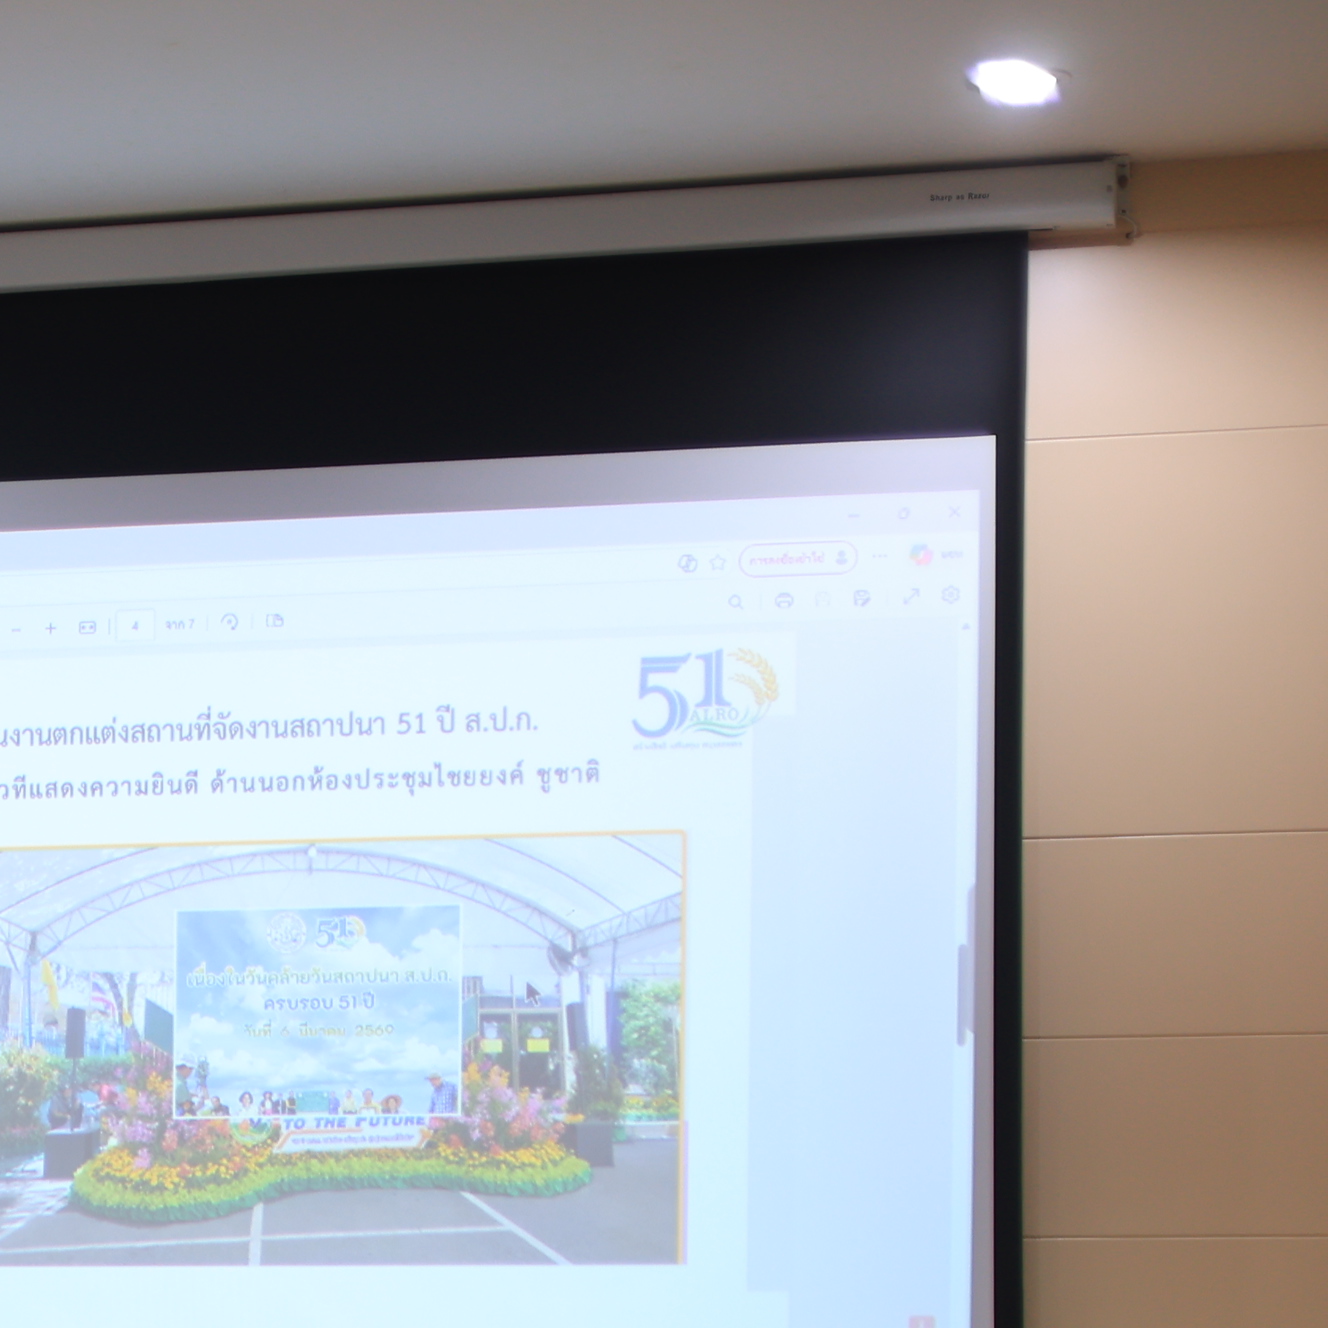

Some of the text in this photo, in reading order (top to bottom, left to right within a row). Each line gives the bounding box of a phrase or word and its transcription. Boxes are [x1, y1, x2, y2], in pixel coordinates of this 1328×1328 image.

[632, 648, 731, 739] 51
[396, 713, 426, 736] 51
[437, 704, 455, 735] ปี
[465, 706, 539, 733] ส.ป.ก.
[689, 707, 740, 722] ALRO
[210, 759, 524, 796] ด้านนอกห้องประชุมไชยยงค์
[538, 758, 600, 793] ชูชาติ
[264, 995, 333, 1011] ครบรอบ
[339, 995, 357, 1010] 51
[314, 1116, 347, 1128] THE
